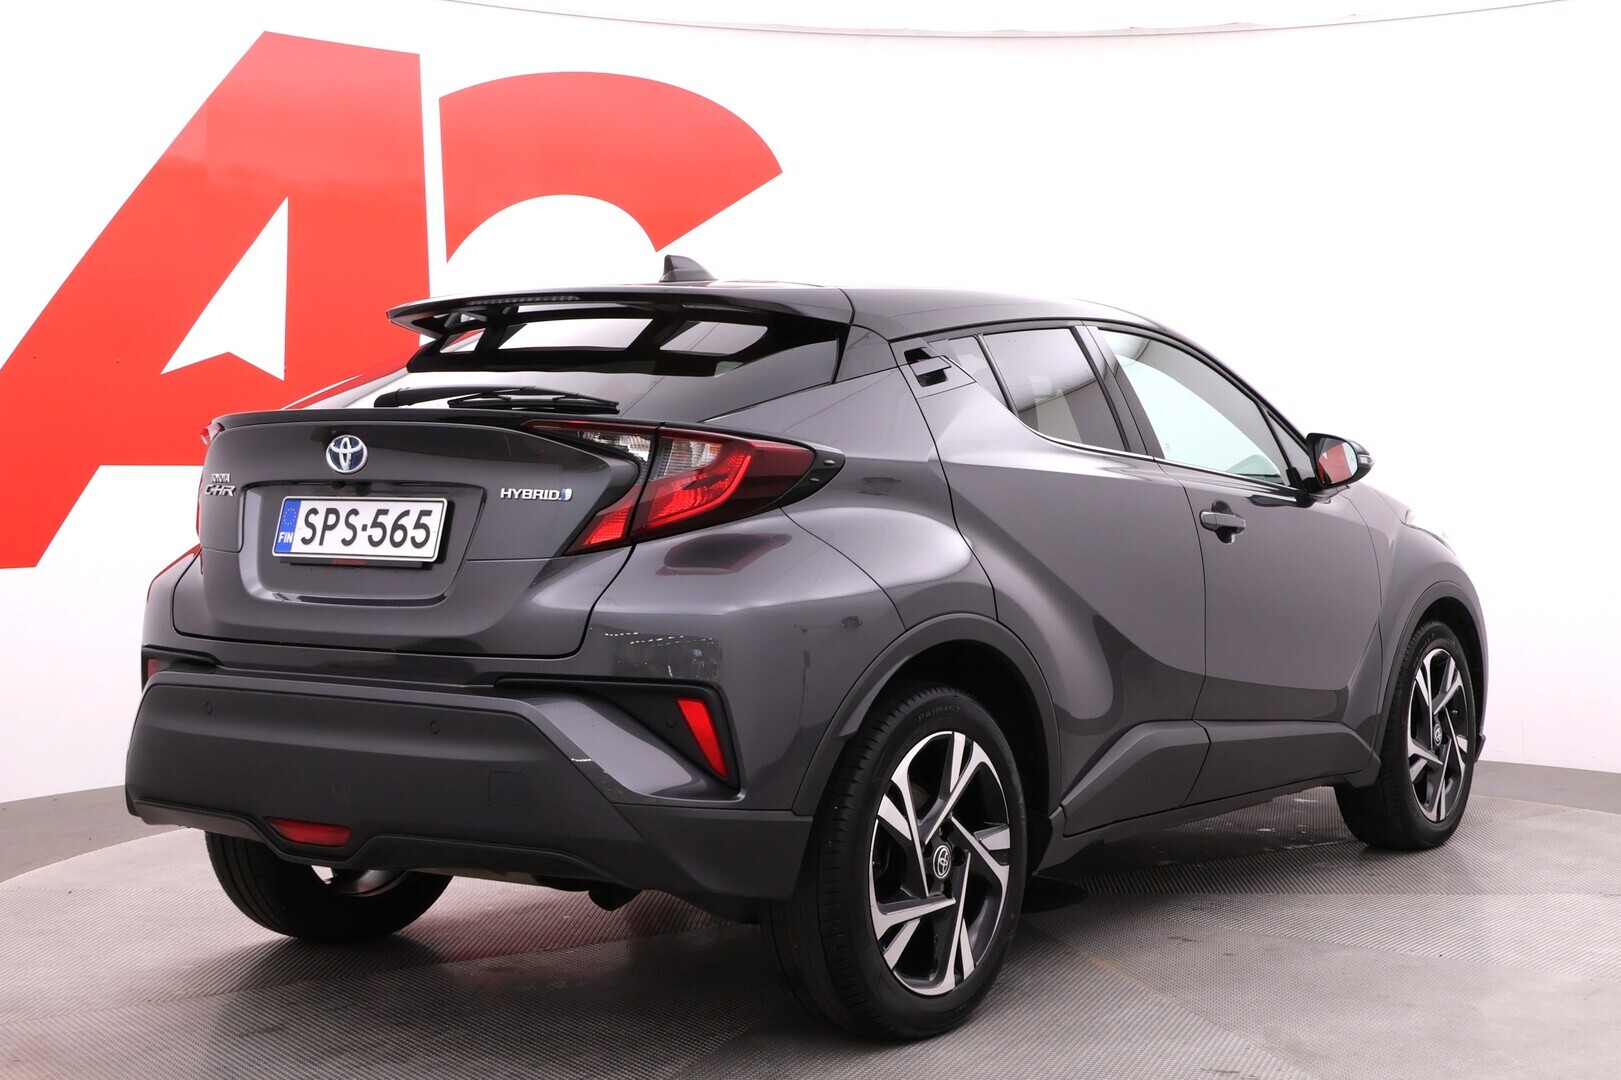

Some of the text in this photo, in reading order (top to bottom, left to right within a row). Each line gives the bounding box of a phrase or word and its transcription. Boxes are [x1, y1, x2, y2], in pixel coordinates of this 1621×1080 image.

[500, 487, 561, 501] HYBRID
[277, 531, 294, 544] FIN
[918, 703, 961, 722] PRIMACY
